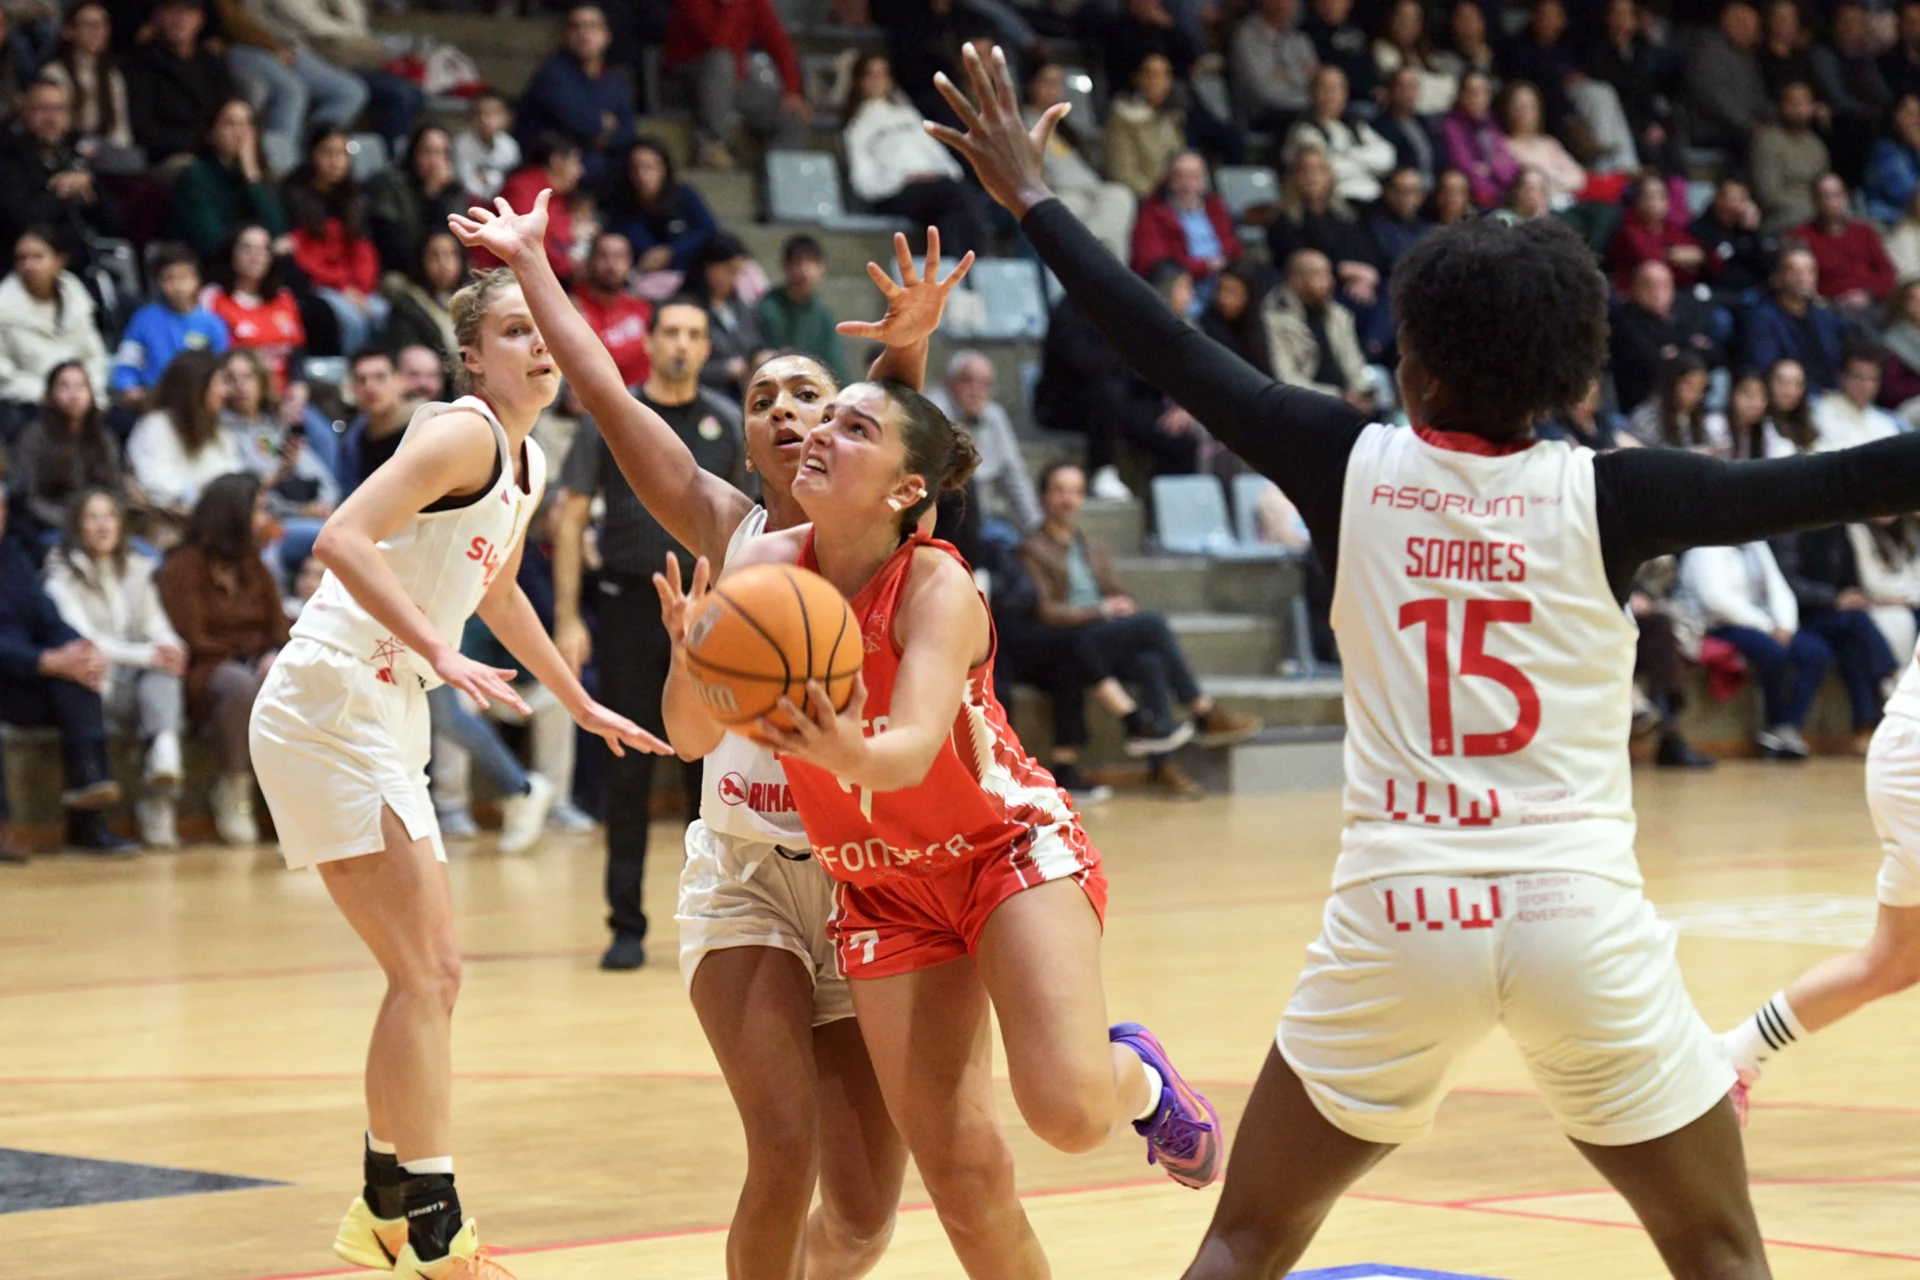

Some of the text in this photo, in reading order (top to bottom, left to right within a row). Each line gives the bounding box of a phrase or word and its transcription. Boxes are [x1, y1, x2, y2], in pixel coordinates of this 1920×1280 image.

[1405, 536, 1526, 582] SOARES
[1399, 598, 1541, 757] 15
[849, 929, 880, 964] 7
